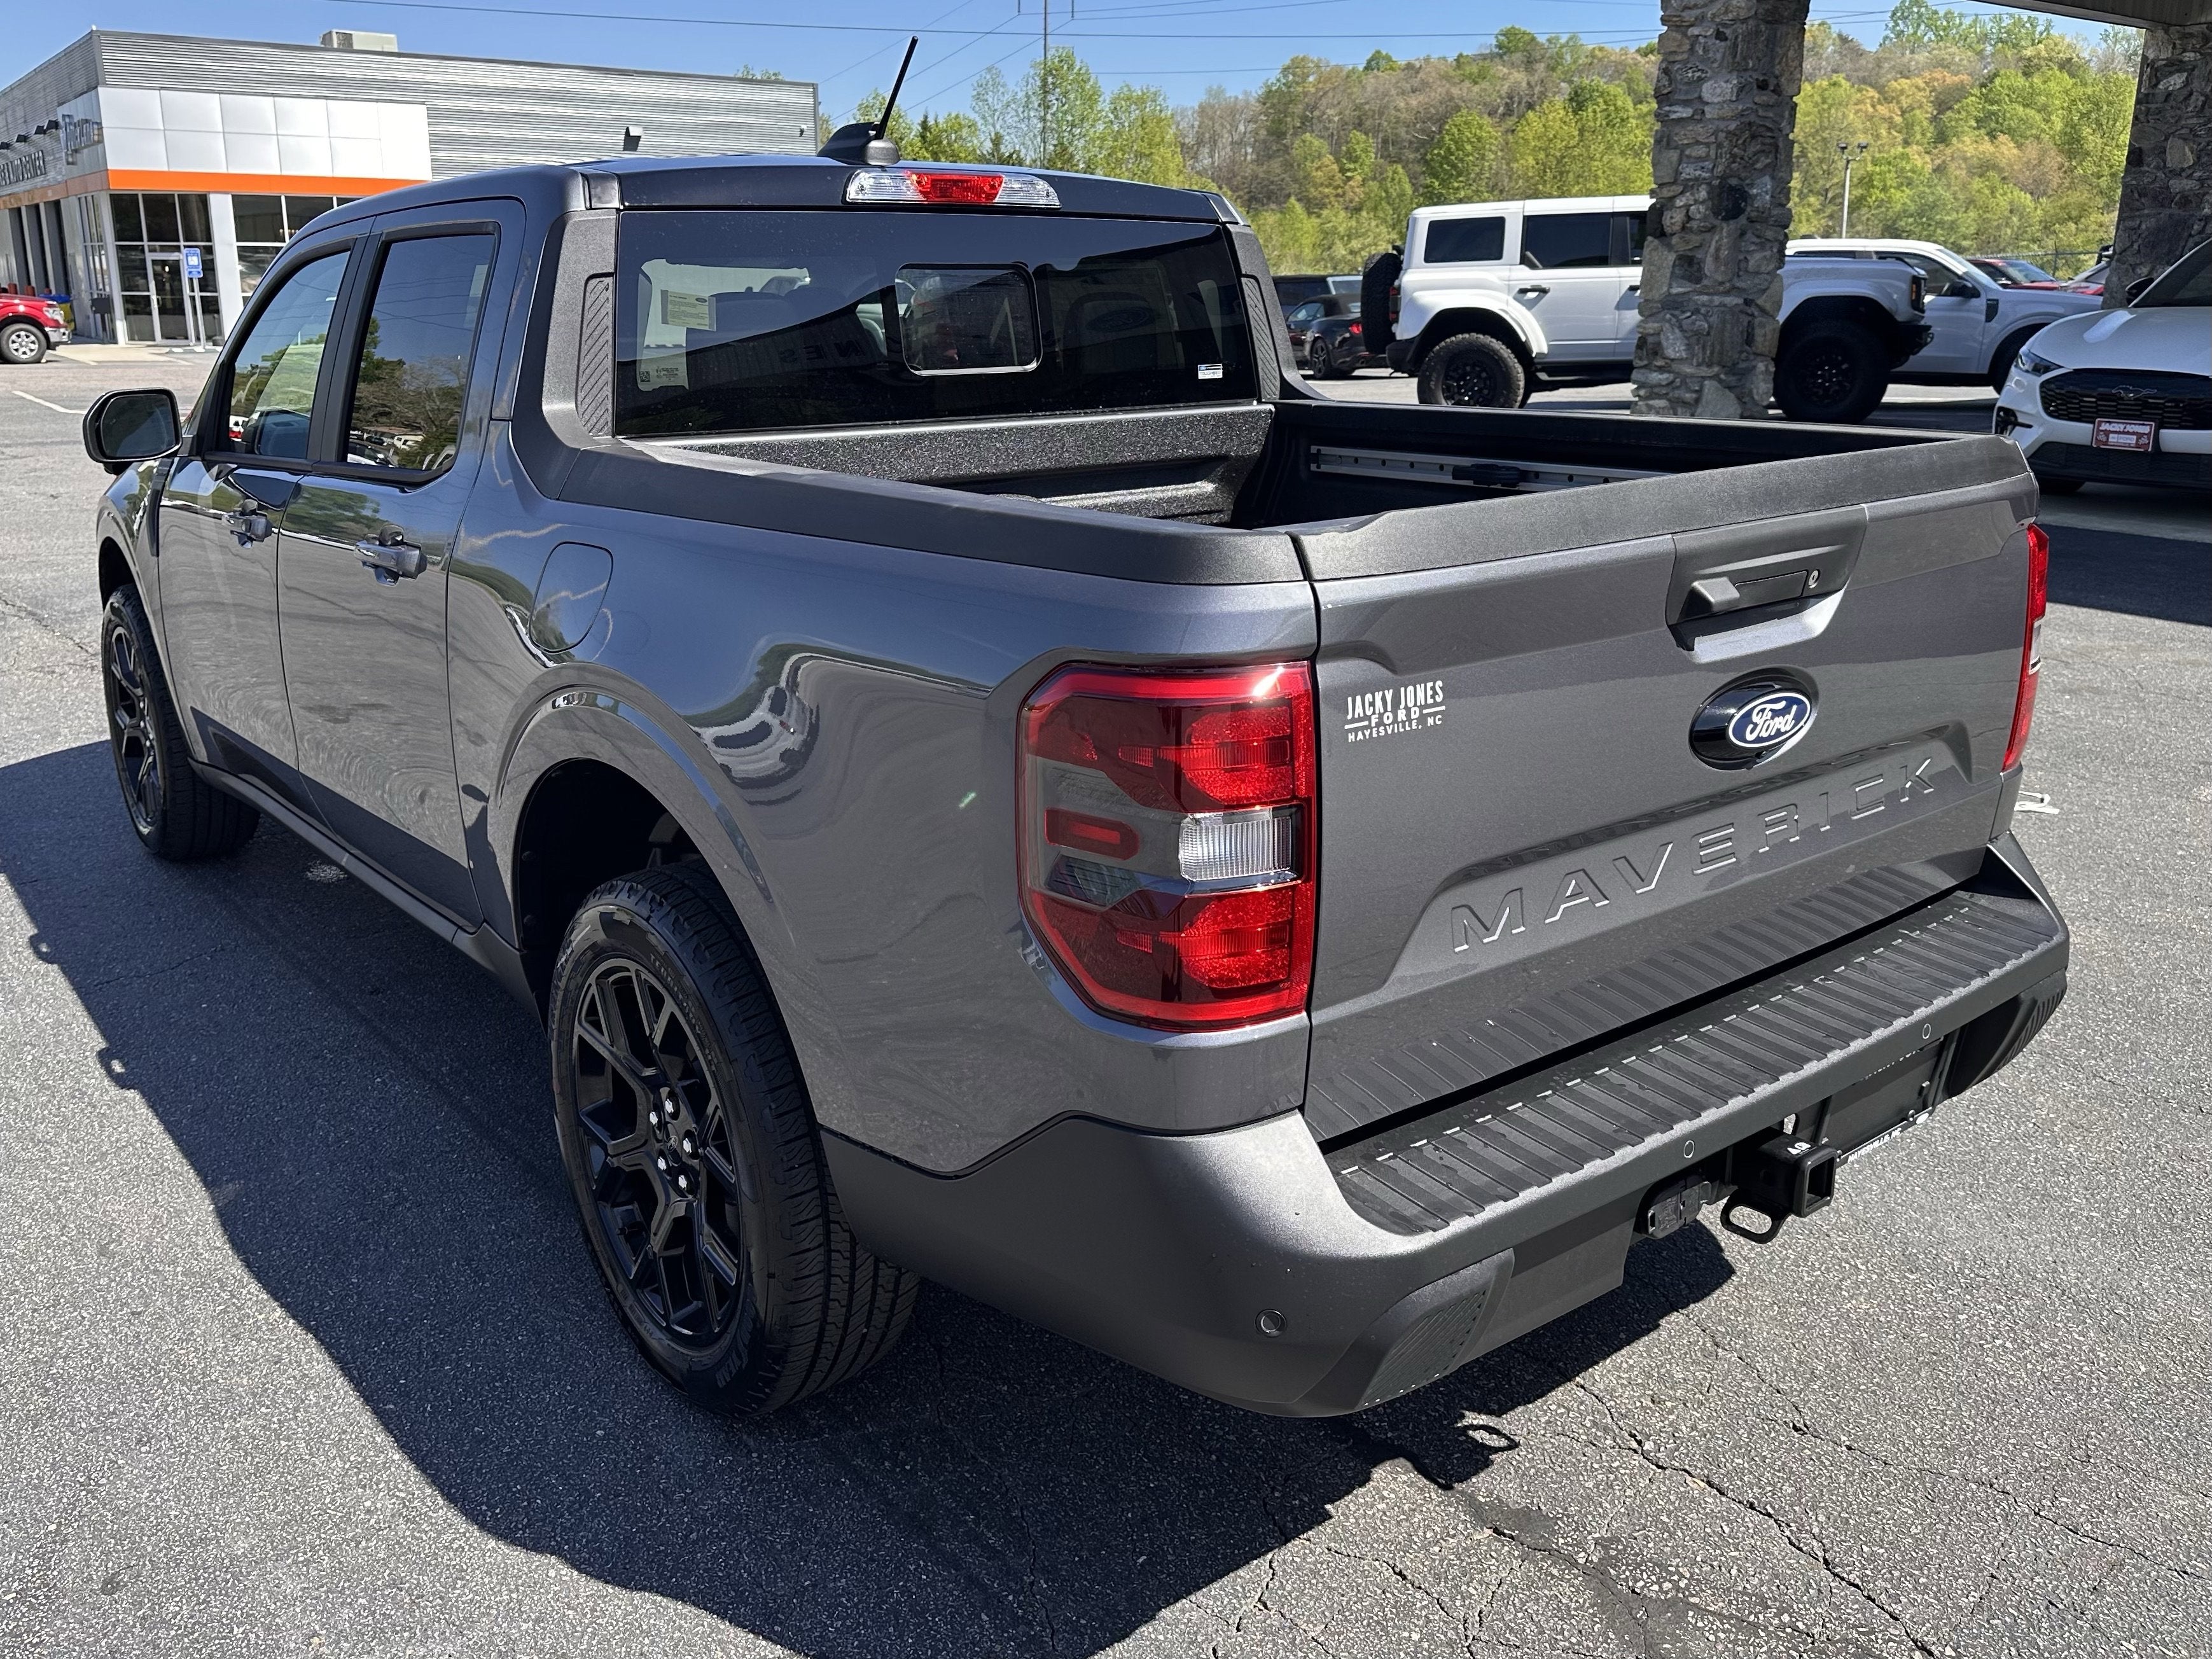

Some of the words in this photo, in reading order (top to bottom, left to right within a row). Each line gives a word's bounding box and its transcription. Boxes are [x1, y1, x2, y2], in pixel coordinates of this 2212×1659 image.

[1347, 689, 1393, 719] JACKY
[1400, 680, 1443, 709] JONES
[1371, 706, 1420, 726] FORD
[1348, 719, 1422, 742] HAYESVILLE,
[1427, 715, 1442, 726] NC
[1746, 700, 1797, 741] Ford
[1452, 758, 1935, 953] MAVERICK
